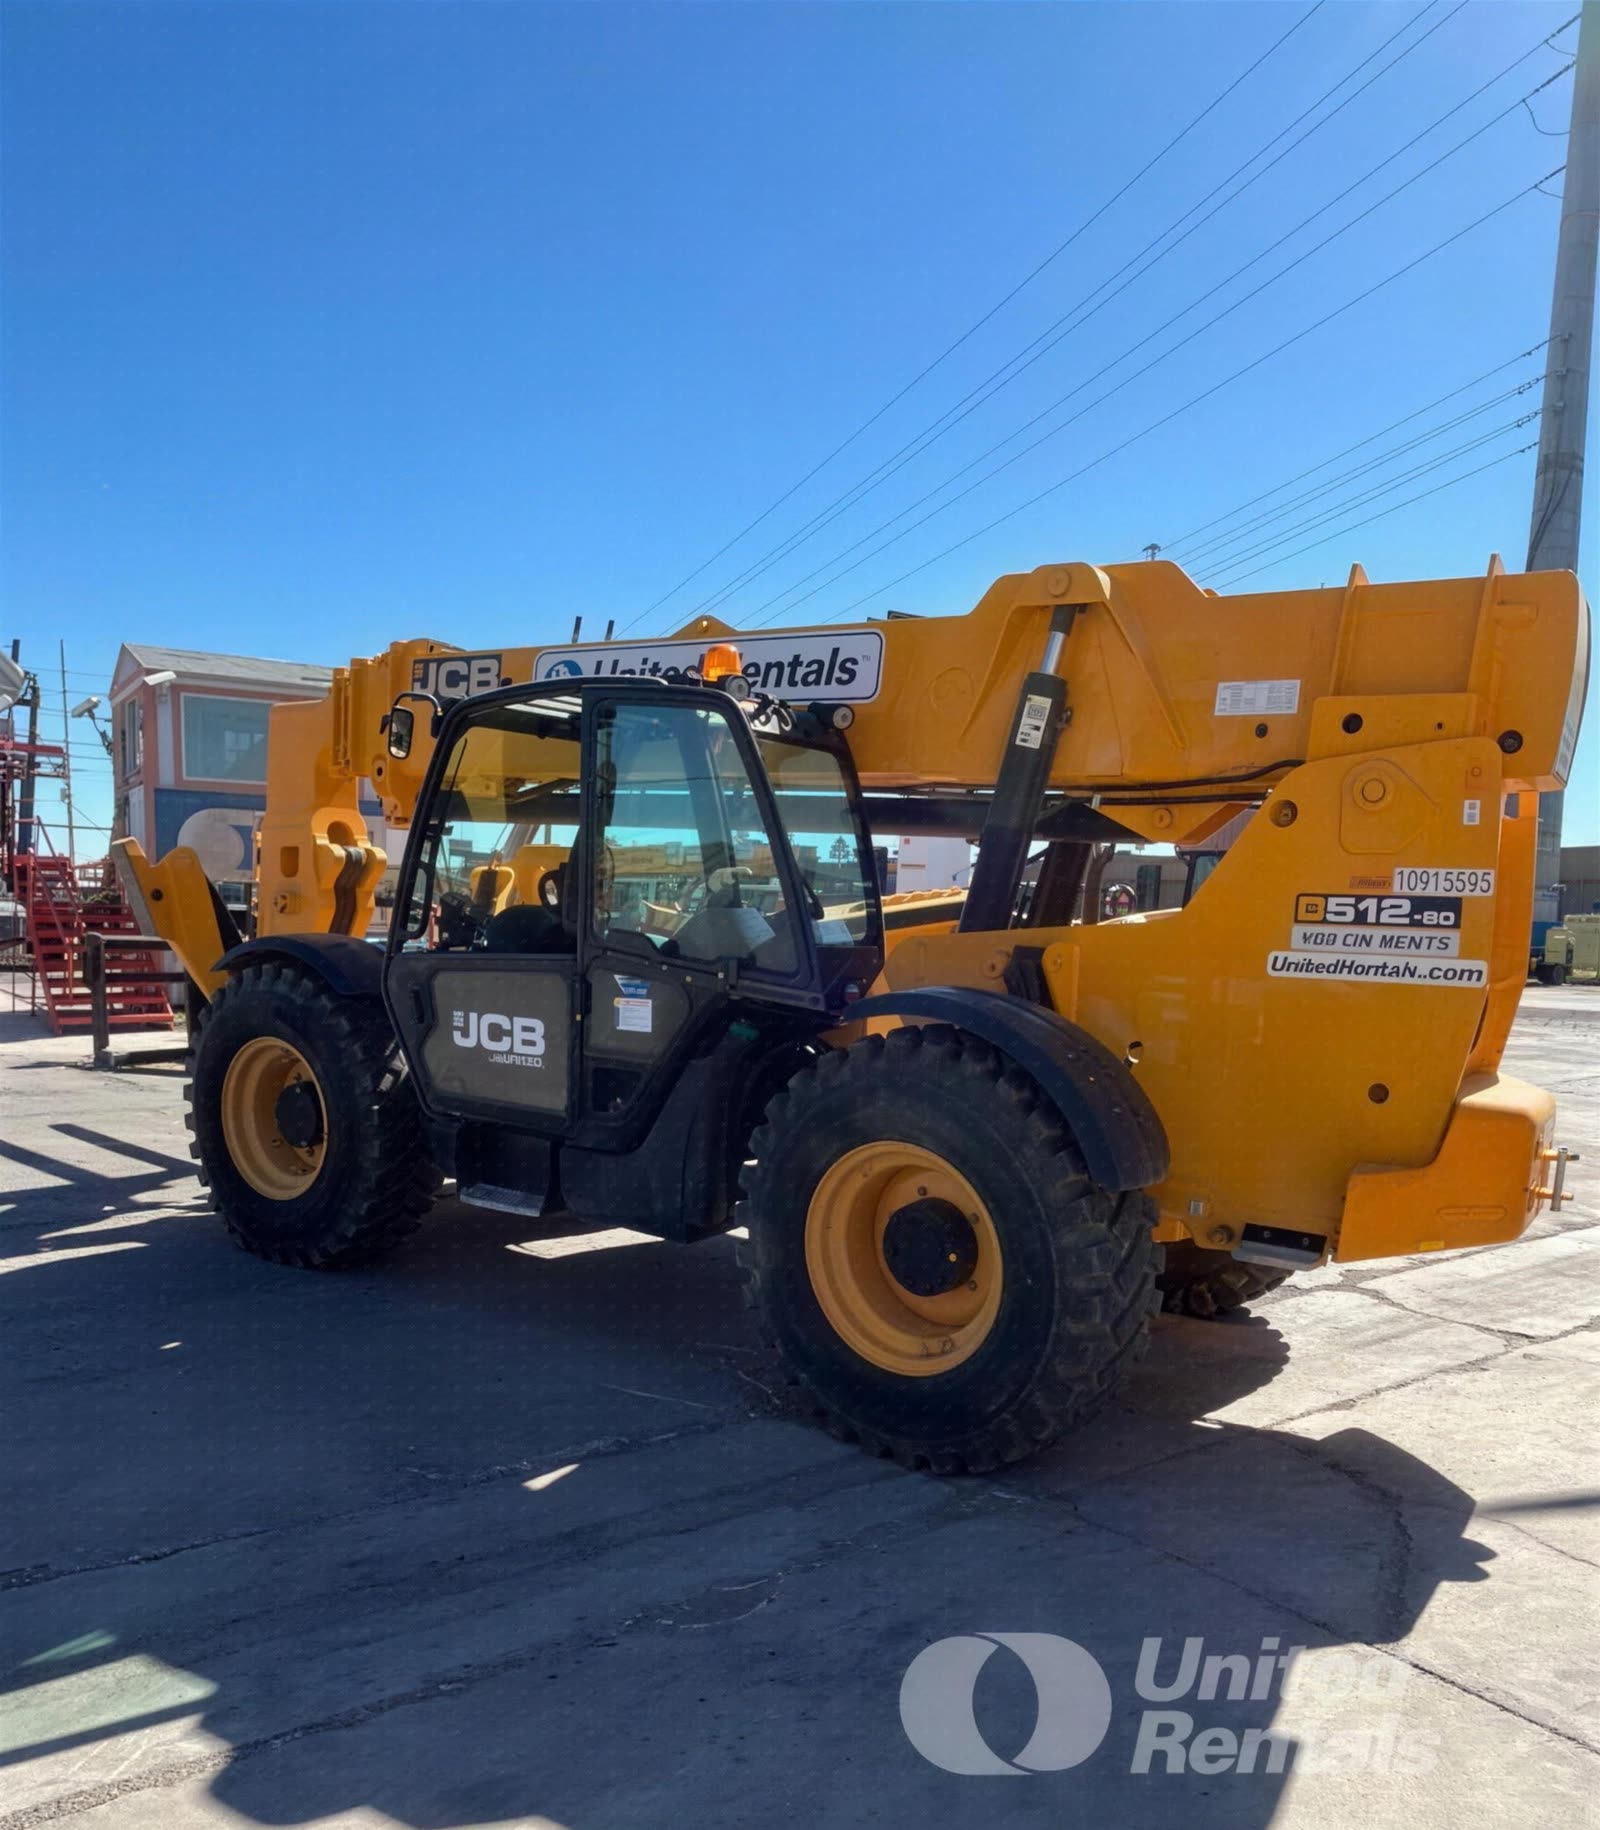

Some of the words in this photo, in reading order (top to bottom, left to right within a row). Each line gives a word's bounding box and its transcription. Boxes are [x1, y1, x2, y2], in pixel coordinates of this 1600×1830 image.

[413, 659, 499, 698] JCB
[738, 647, 859, 688] entals
[1397, 870, 1491, 893] 10915595
[1379, 935, 1451, 951] MENTS
[453, 1010, 545, 1056] JCB
